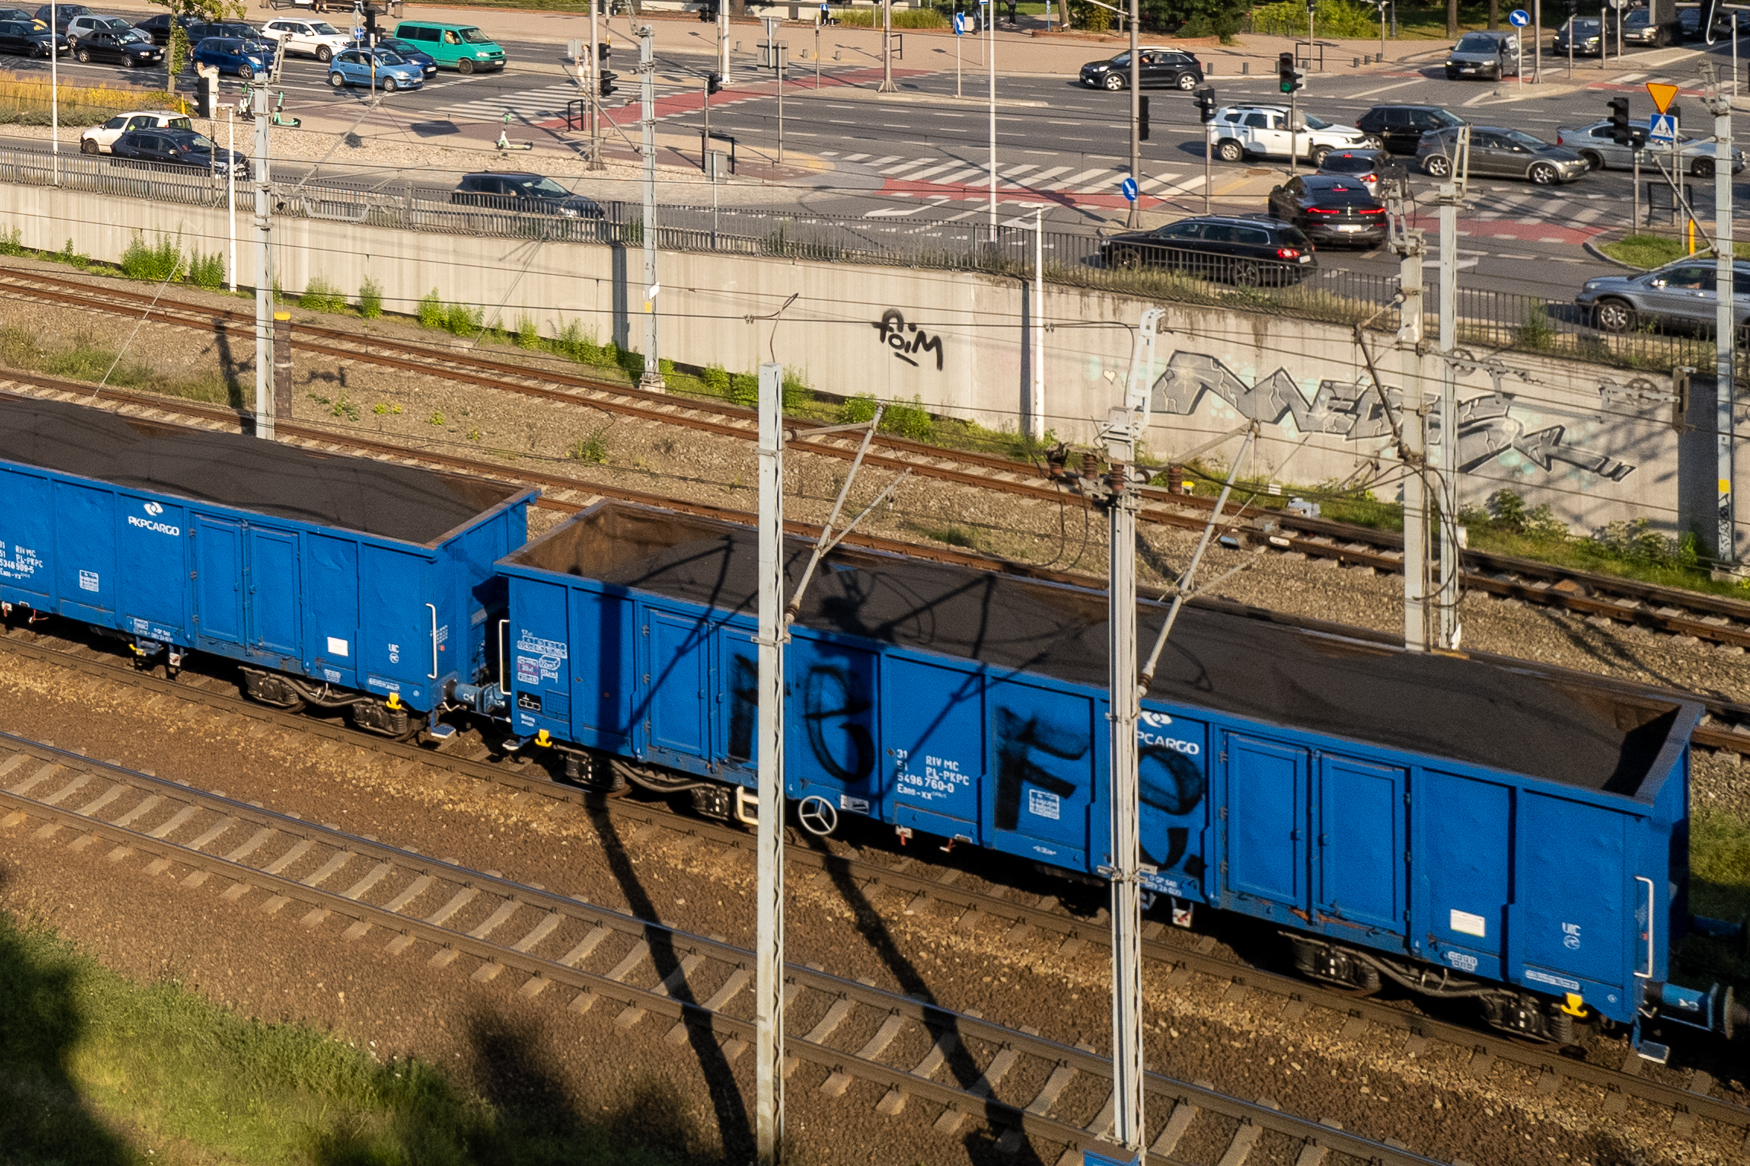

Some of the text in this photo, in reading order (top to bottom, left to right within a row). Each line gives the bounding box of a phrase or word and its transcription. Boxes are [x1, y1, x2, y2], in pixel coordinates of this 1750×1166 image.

[1136, 730, 1200, 755] PCARGO
[896, 749, 959, 772] 31 RIV MC
[896, 760, 970, 786] 51 PL-PKPC
[897, 772, 955, 794] 5496 760-0
[1562, 922, 1582, 937] UIC
